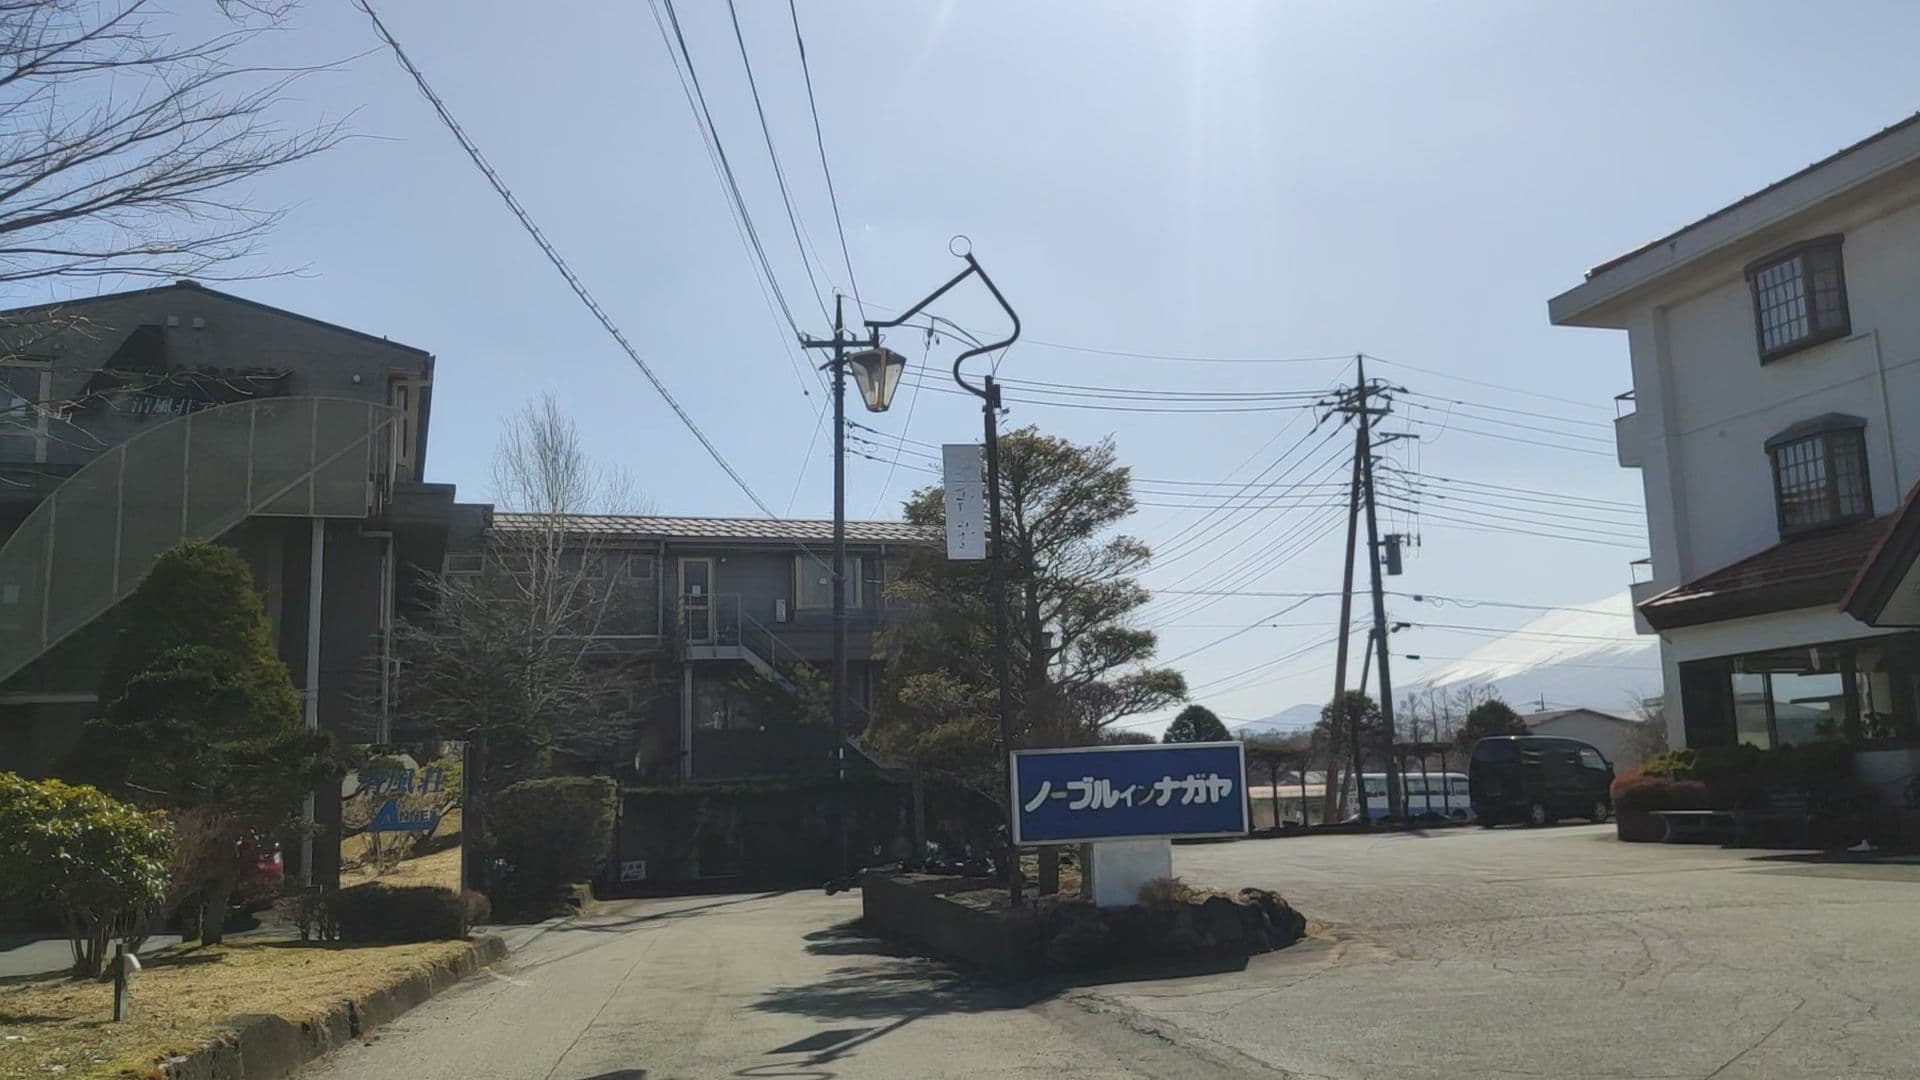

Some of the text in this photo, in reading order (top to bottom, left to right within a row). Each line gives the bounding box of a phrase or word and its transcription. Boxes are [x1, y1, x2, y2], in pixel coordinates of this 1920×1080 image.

[1025, 773, 1233, 813] ノーブルインナガヤ
